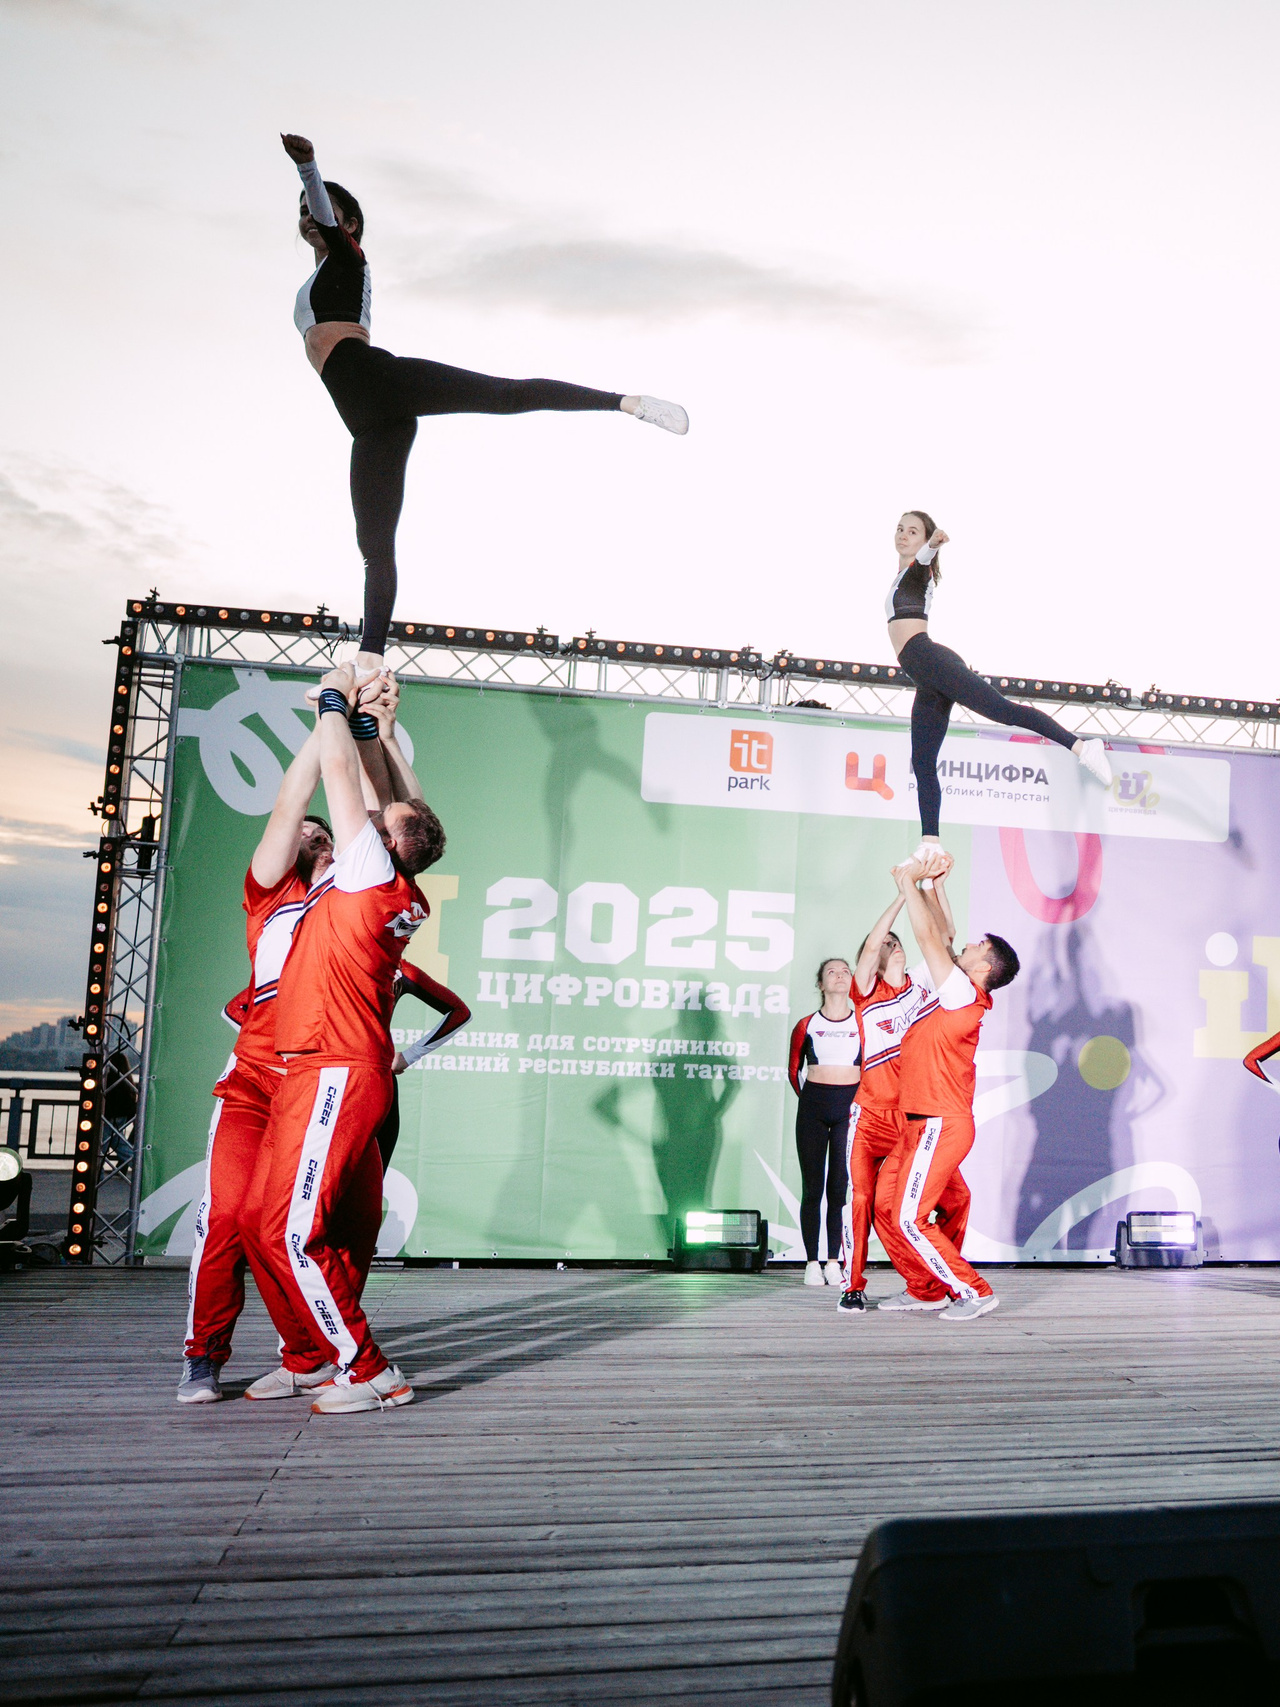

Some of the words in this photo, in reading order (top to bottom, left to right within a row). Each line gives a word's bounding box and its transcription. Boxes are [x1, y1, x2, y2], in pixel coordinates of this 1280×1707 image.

[734, 734, 768, 769] it
[727, 776, 770, 791] park
[909, 758, 1049, 785] ИНЦИФРА
[986, 788, 1050, 802] Татарстан
[481, 876, 796, 972] 2025
[319, 1086, 337, 1127] CHEER
[924, 1128, 936, 1151] CHEER
[301, 1159, 318, 1201] CHEER
[910, 1171, 922, 1199] CHEER
[291, 1233, 309, 1269] CHEER
[314, 1299, 339, 1336] CHEER
